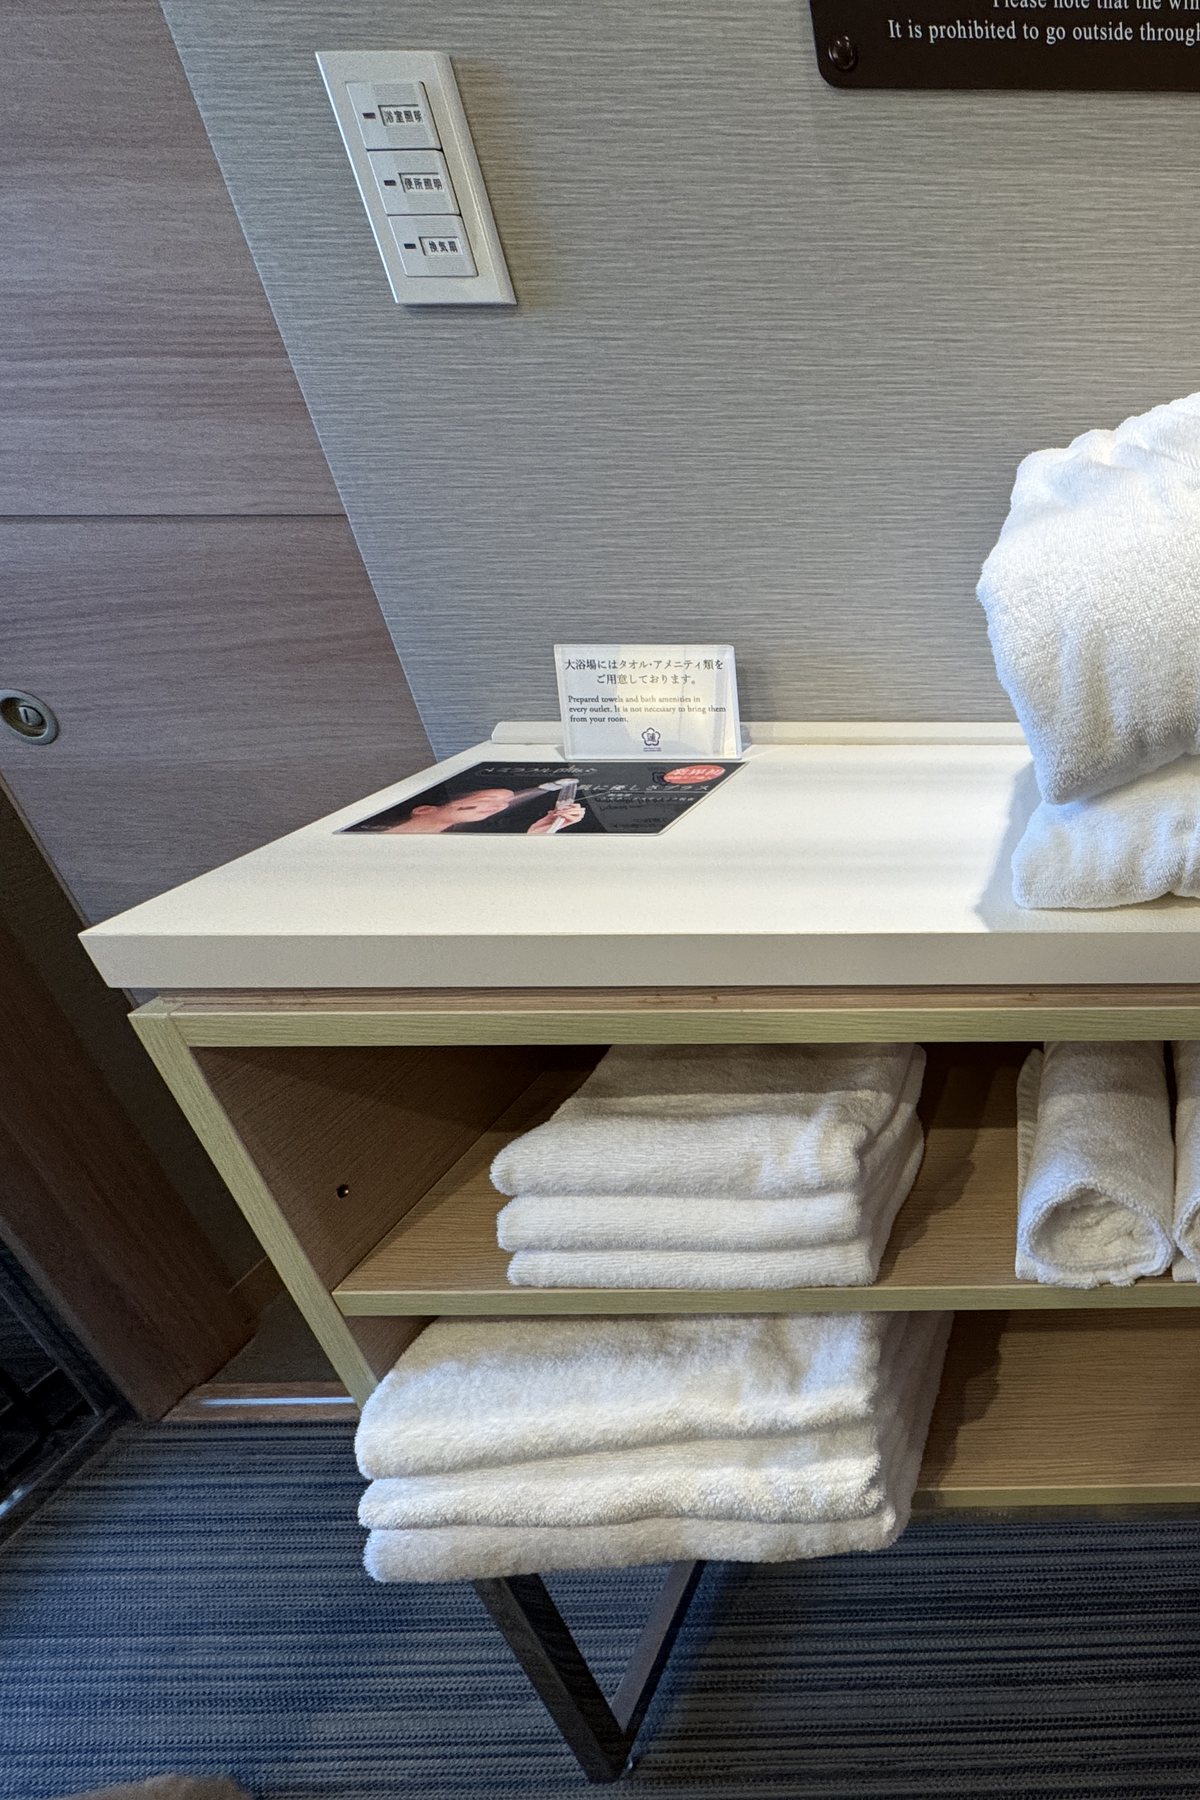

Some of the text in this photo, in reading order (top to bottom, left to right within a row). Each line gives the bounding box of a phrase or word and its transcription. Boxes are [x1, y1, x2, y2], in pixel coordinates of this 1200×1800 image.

[887, 19, 902, 38] It
[908, 20, 923, 39] is
[928, 20, 1017, 44] prohibited
[1022, 23, 1039, 41] to
[1046, 26, 1066, 46] go
[1072, 21, 1133, 41] outside
[565, 659, 724, 670] 大浴場にはタオル・アメニティ類を
[596, 674, 696, 685] ご用意しております。
[568, 695, 599, 704] Prepared
[569, 706, 588, 714] every
[589, 705, 612, 713] outlet.
[687, 705, 706, 714] bring
[708, 705, 726, 713] them
